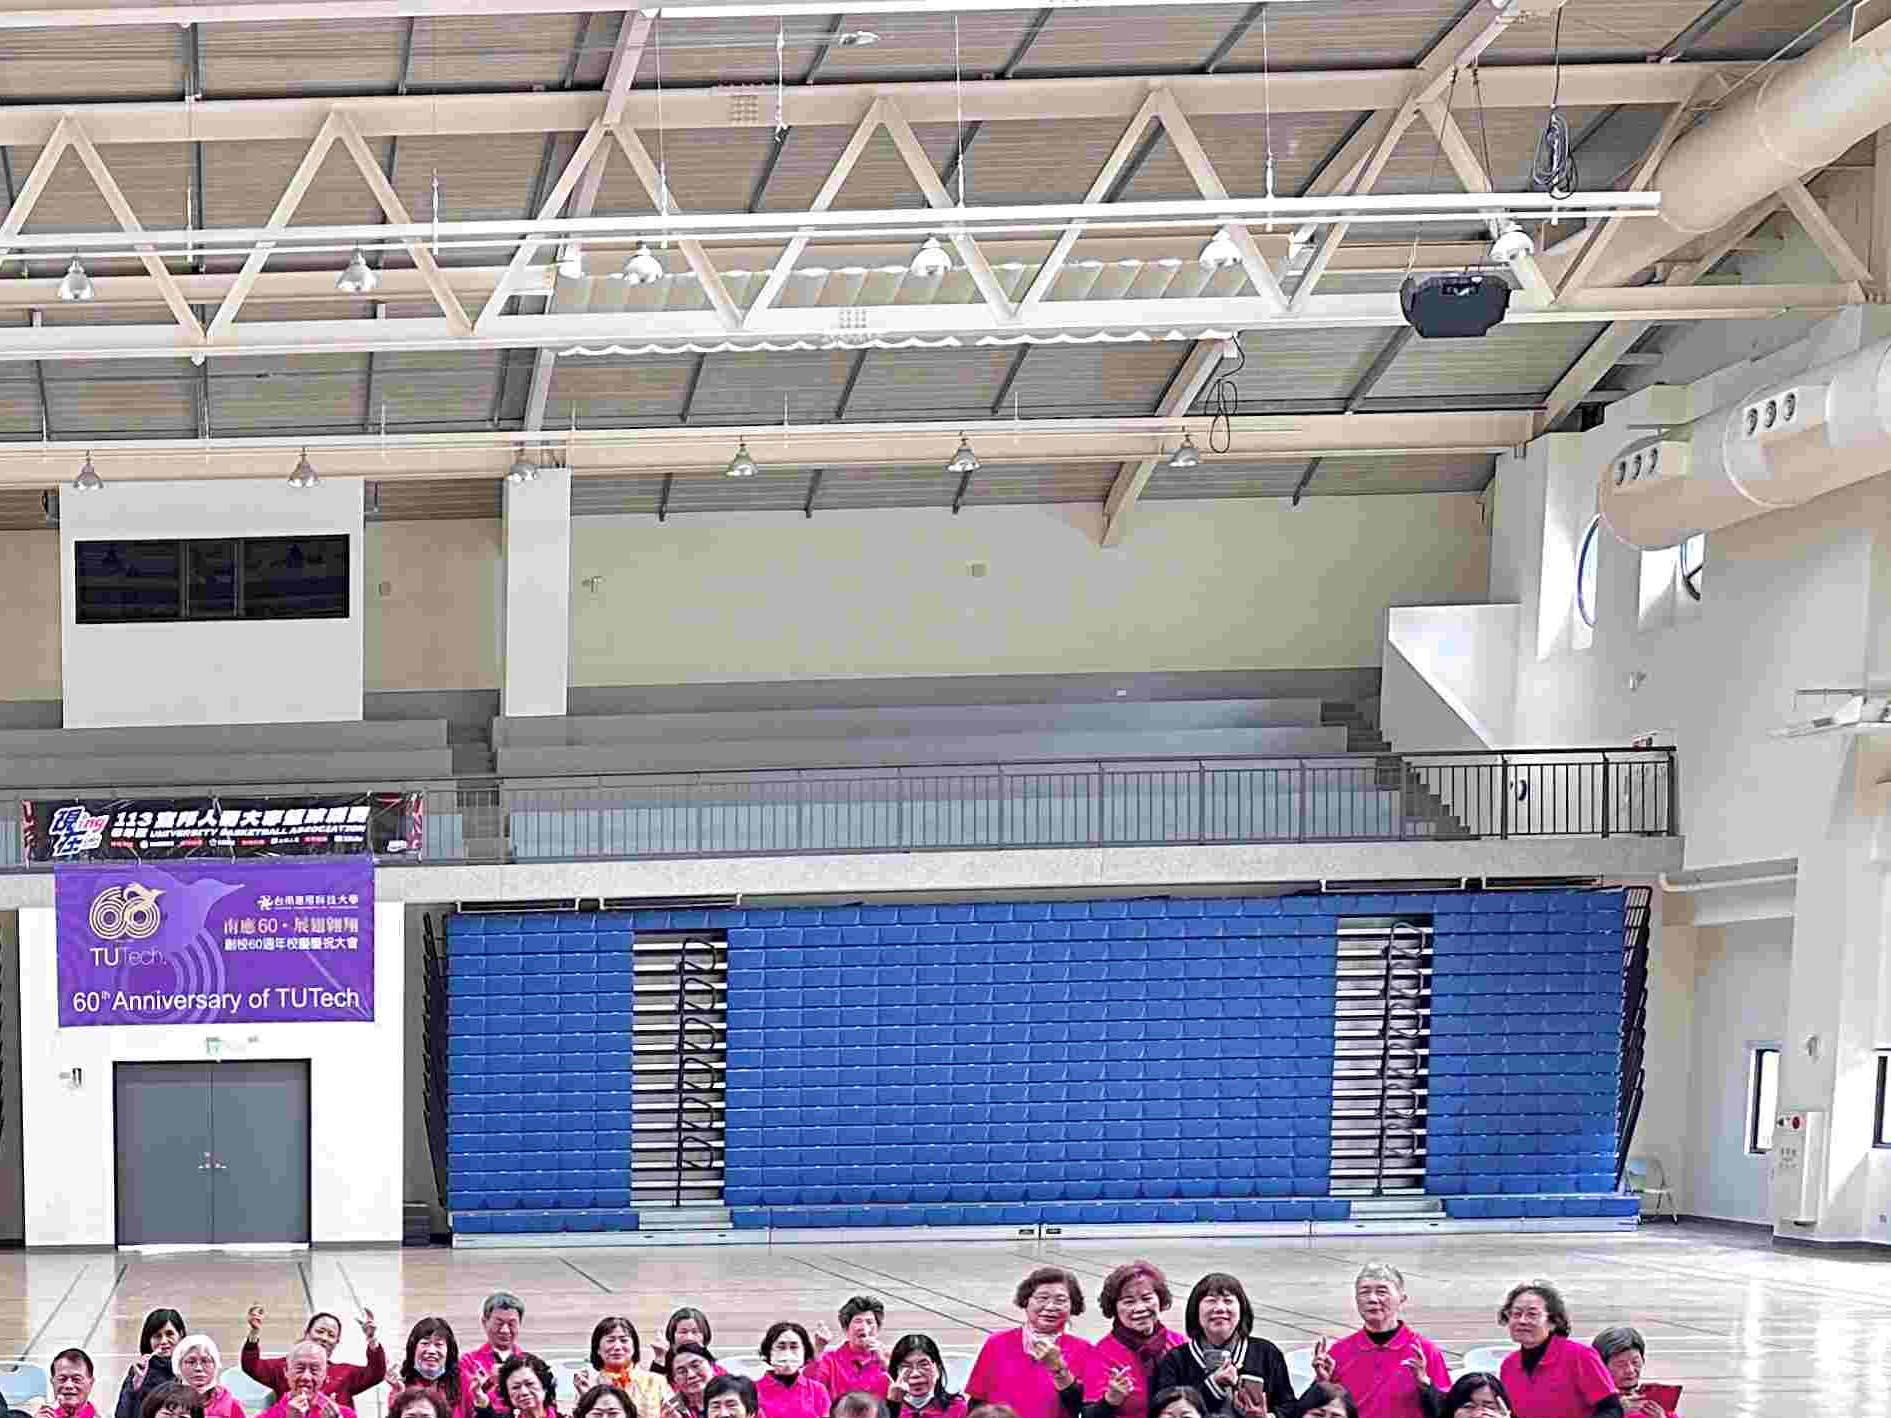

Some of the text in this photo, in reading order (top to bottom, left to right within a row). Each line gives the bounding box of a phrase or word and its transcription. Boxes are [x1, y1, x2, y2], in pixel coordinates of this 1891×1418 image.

[113, 812, 153, 827] 113
[72, 987, 360, 1014] 60th Anniversary of TUTech
